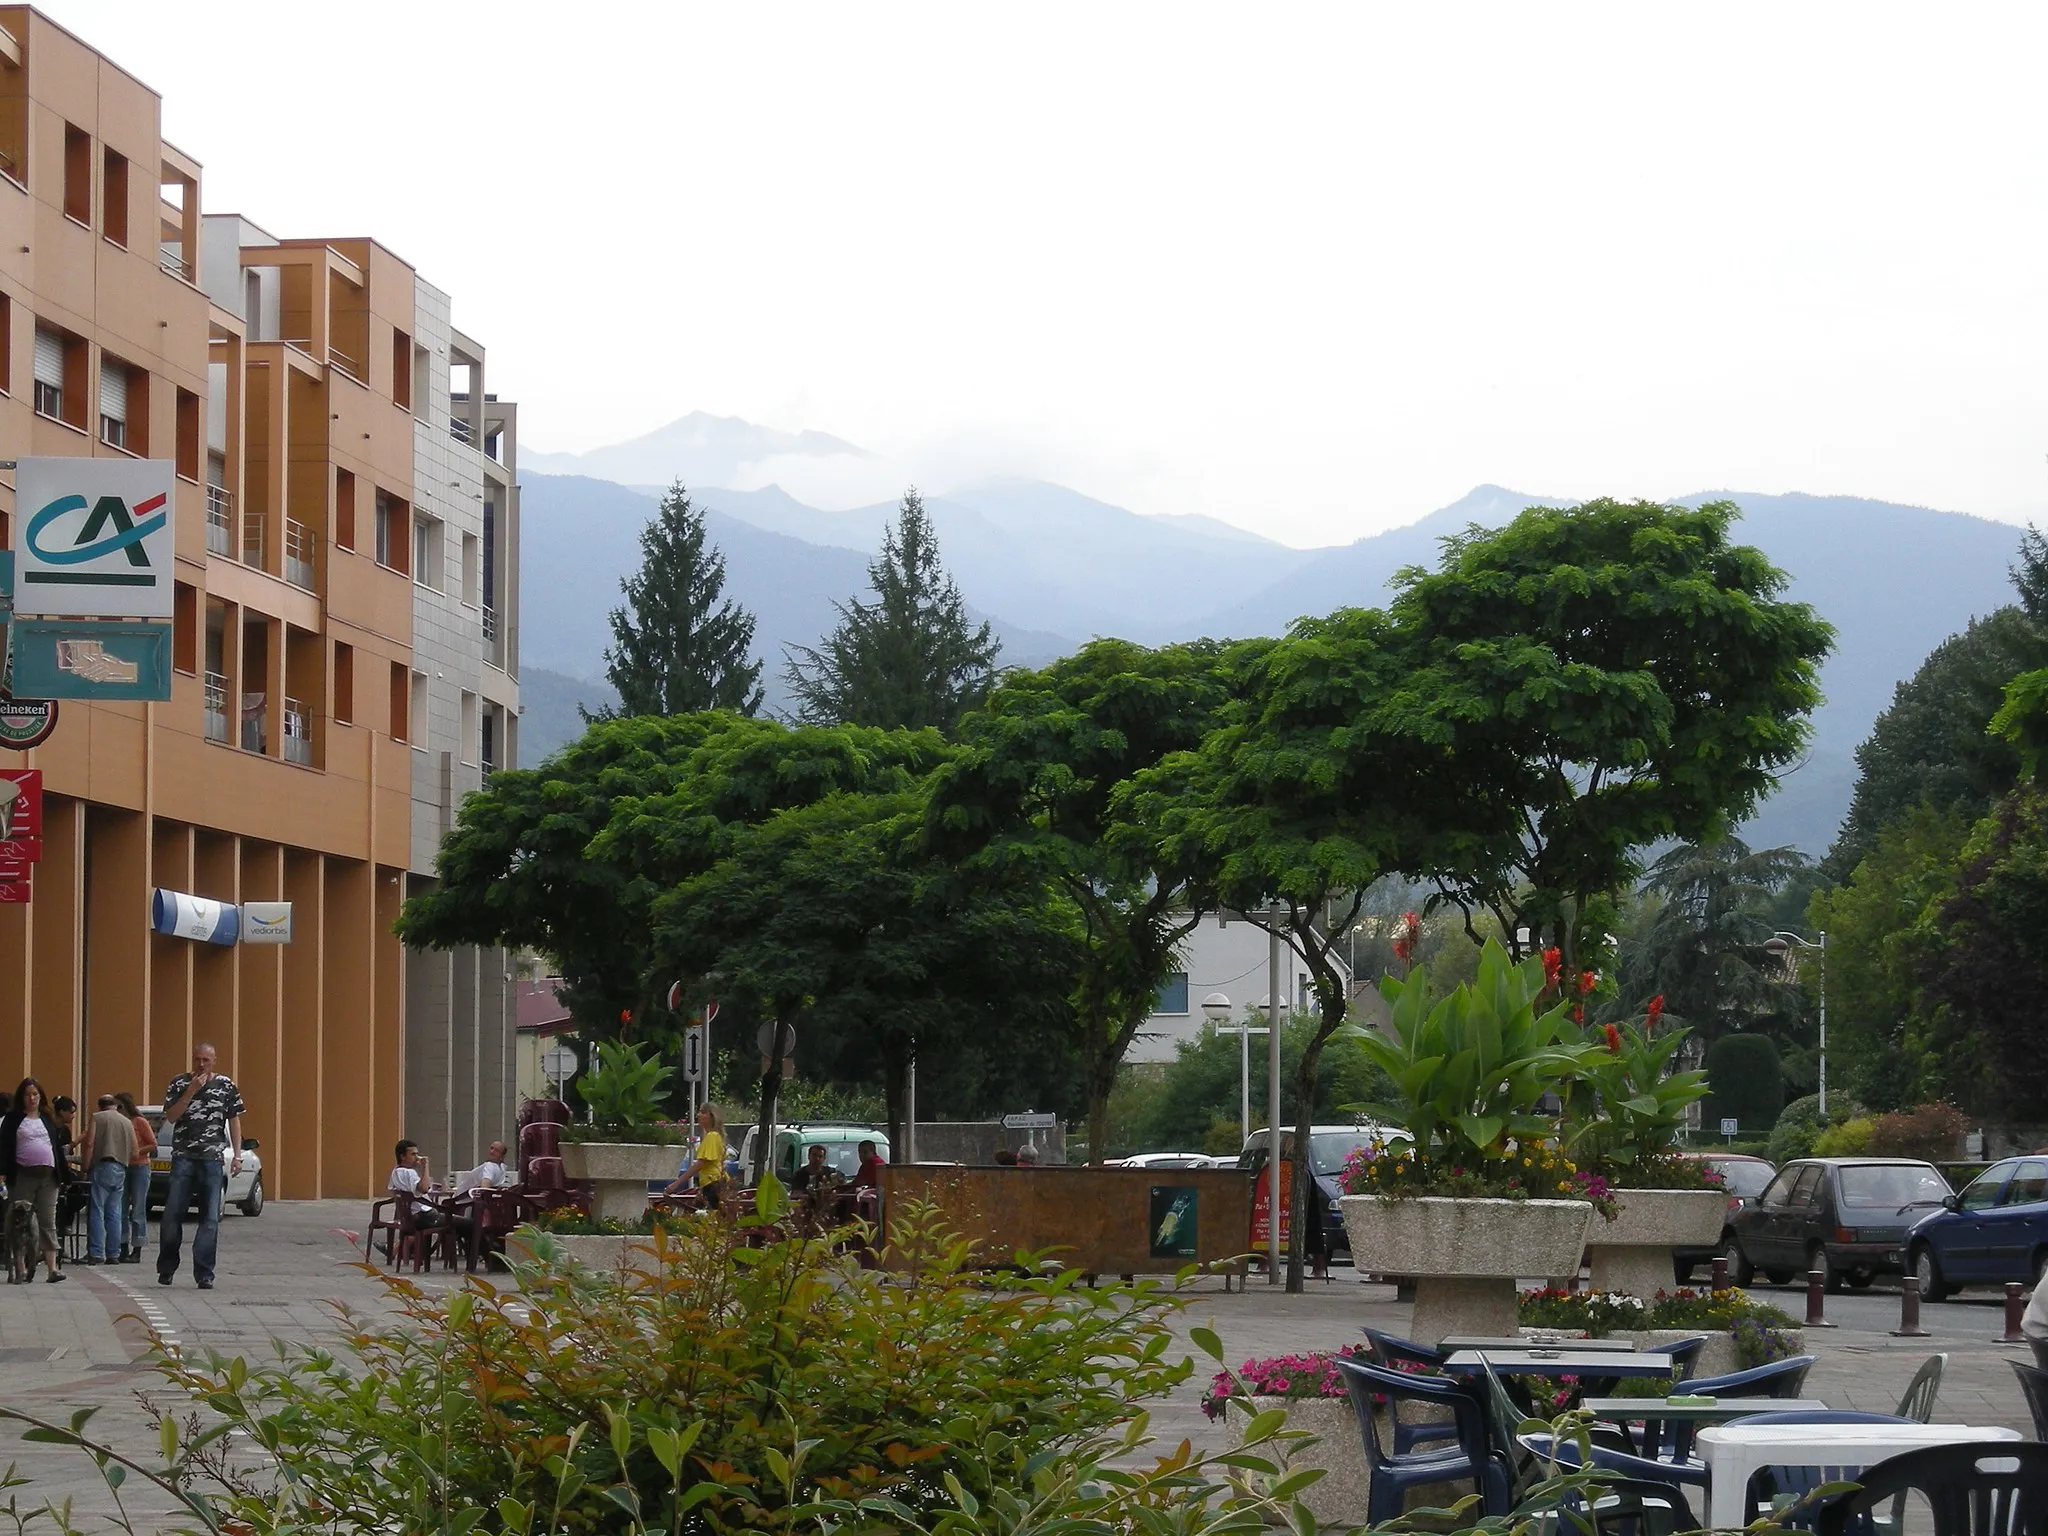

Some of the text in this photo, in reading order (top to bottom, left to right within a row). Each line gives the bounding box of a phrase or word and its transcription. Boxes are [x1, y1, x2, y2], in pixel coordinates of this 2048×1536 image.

[26, 492, 166, 567] CA
[0, 704, 46, 715] eineken
[250, 927, 287, 935] vediorbis
